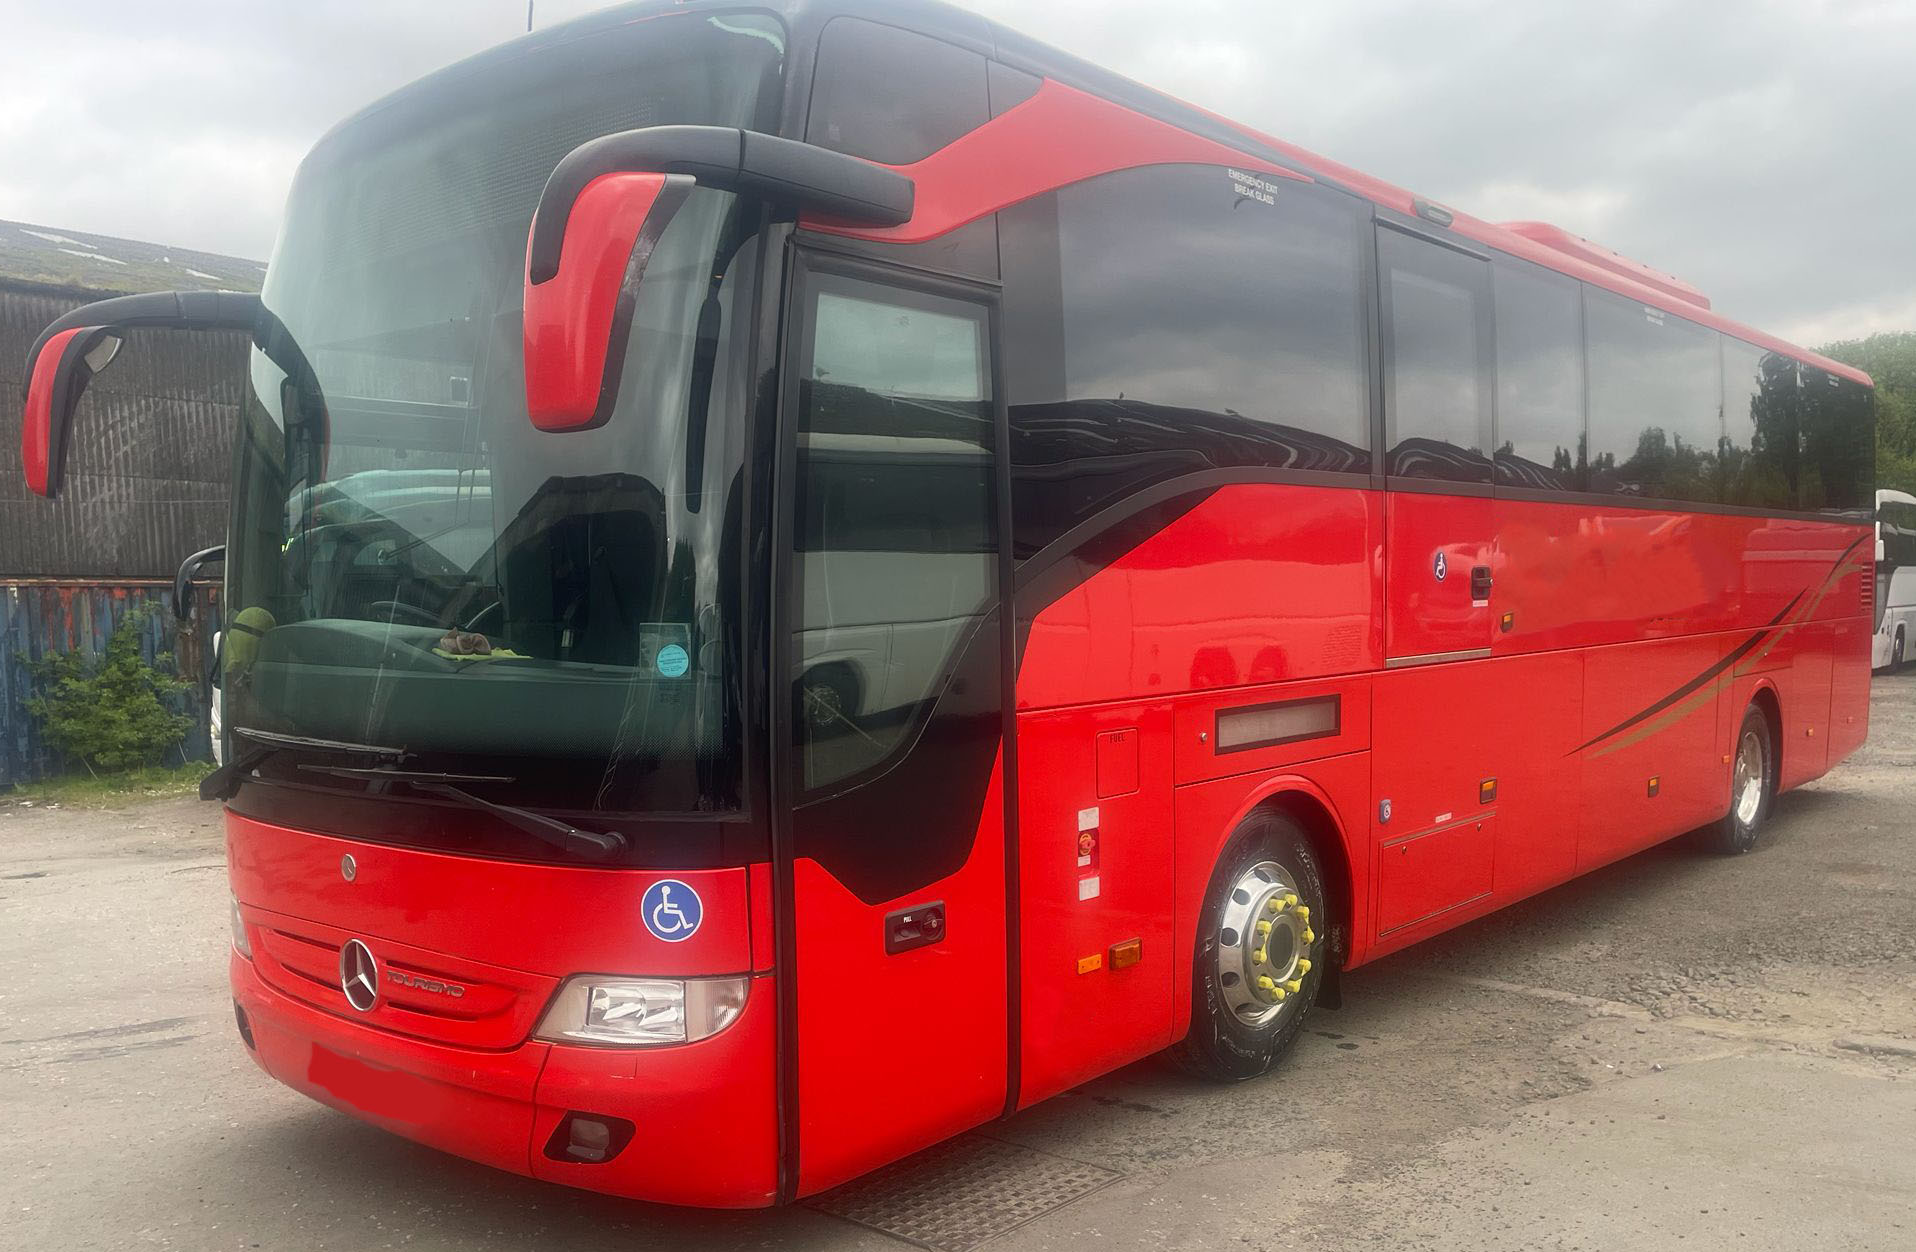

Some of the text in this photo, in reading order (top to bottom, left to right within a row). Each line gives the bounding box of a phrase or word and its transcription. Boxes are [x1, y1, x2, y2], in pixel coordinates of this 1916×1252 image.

[1228, 168, 1278, 194] EMERGENCY EXIT
[1234, 183, 1275, 205] BREAK GLASS
[1109, 732, 1125, 743] FUEL
[387, 970, 465, 997] TOURISMO
